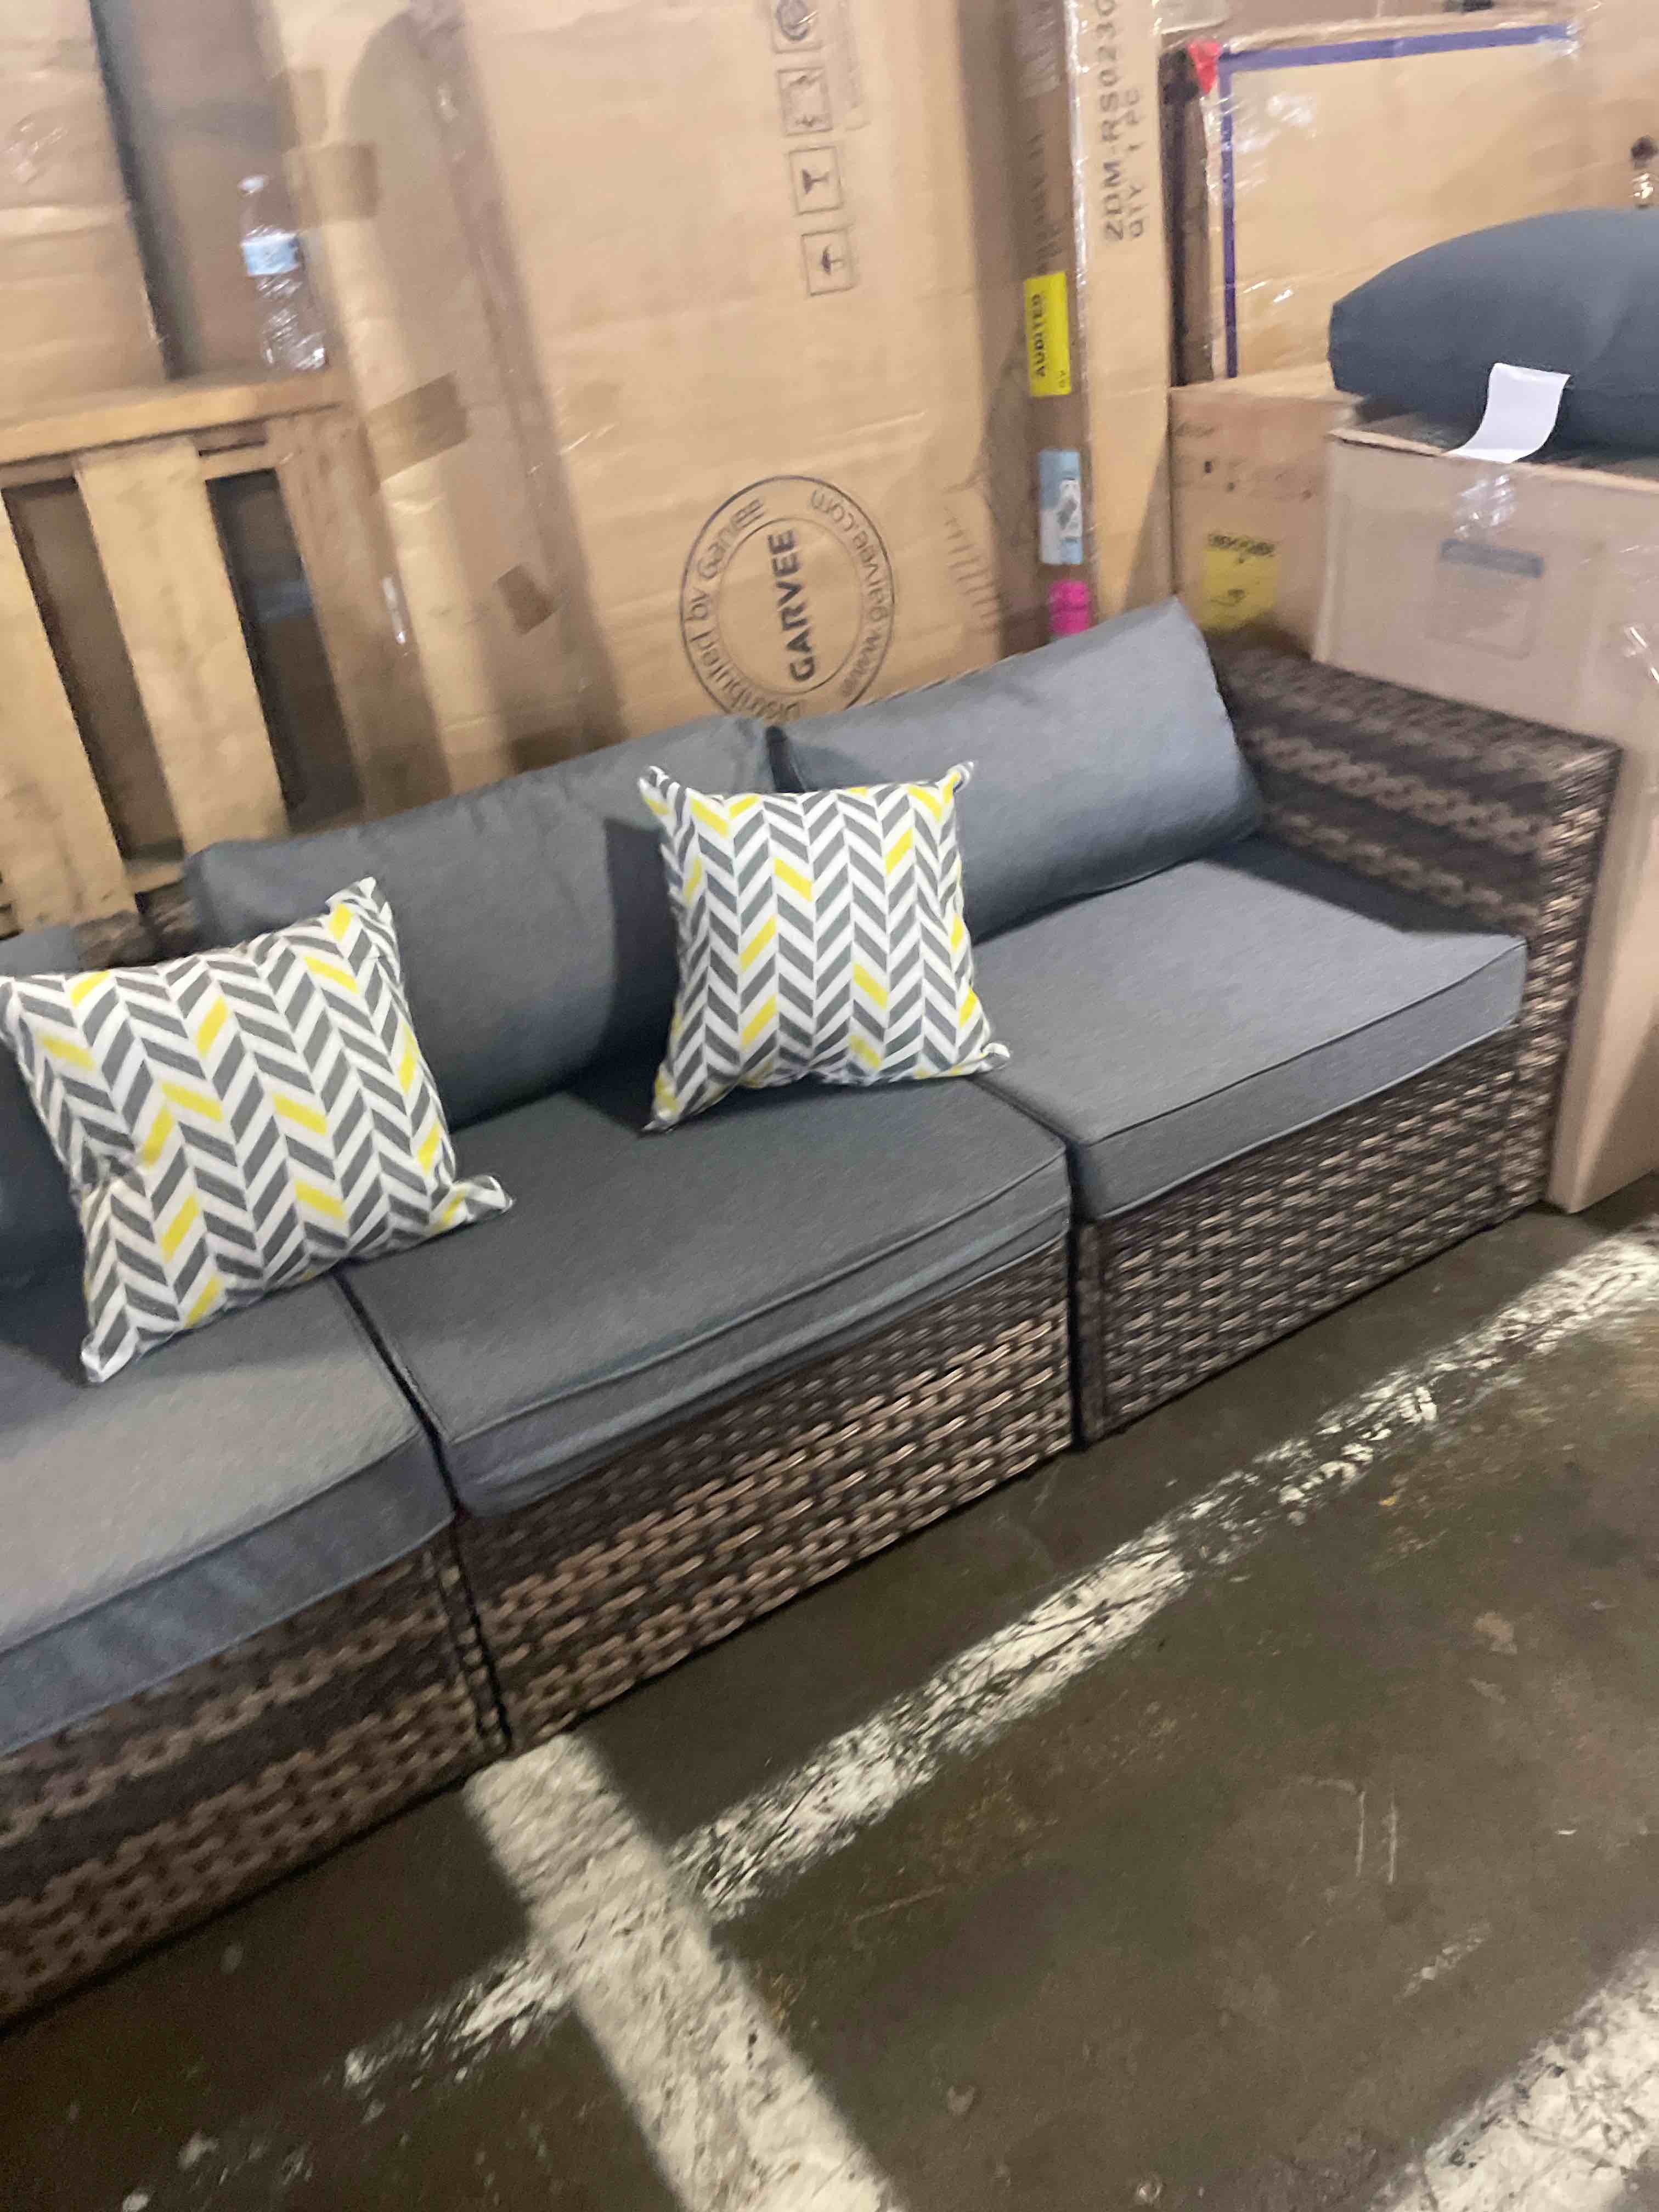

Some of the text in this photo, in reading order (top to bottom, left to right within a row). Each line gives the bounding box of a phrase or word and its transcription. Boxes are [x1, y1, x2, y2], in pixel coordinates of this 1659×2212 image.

[1031, 294, 1046, 376] AUDITED
[684, 586, 710, 622] by
[768, 528, 816, 682] GARVEE
